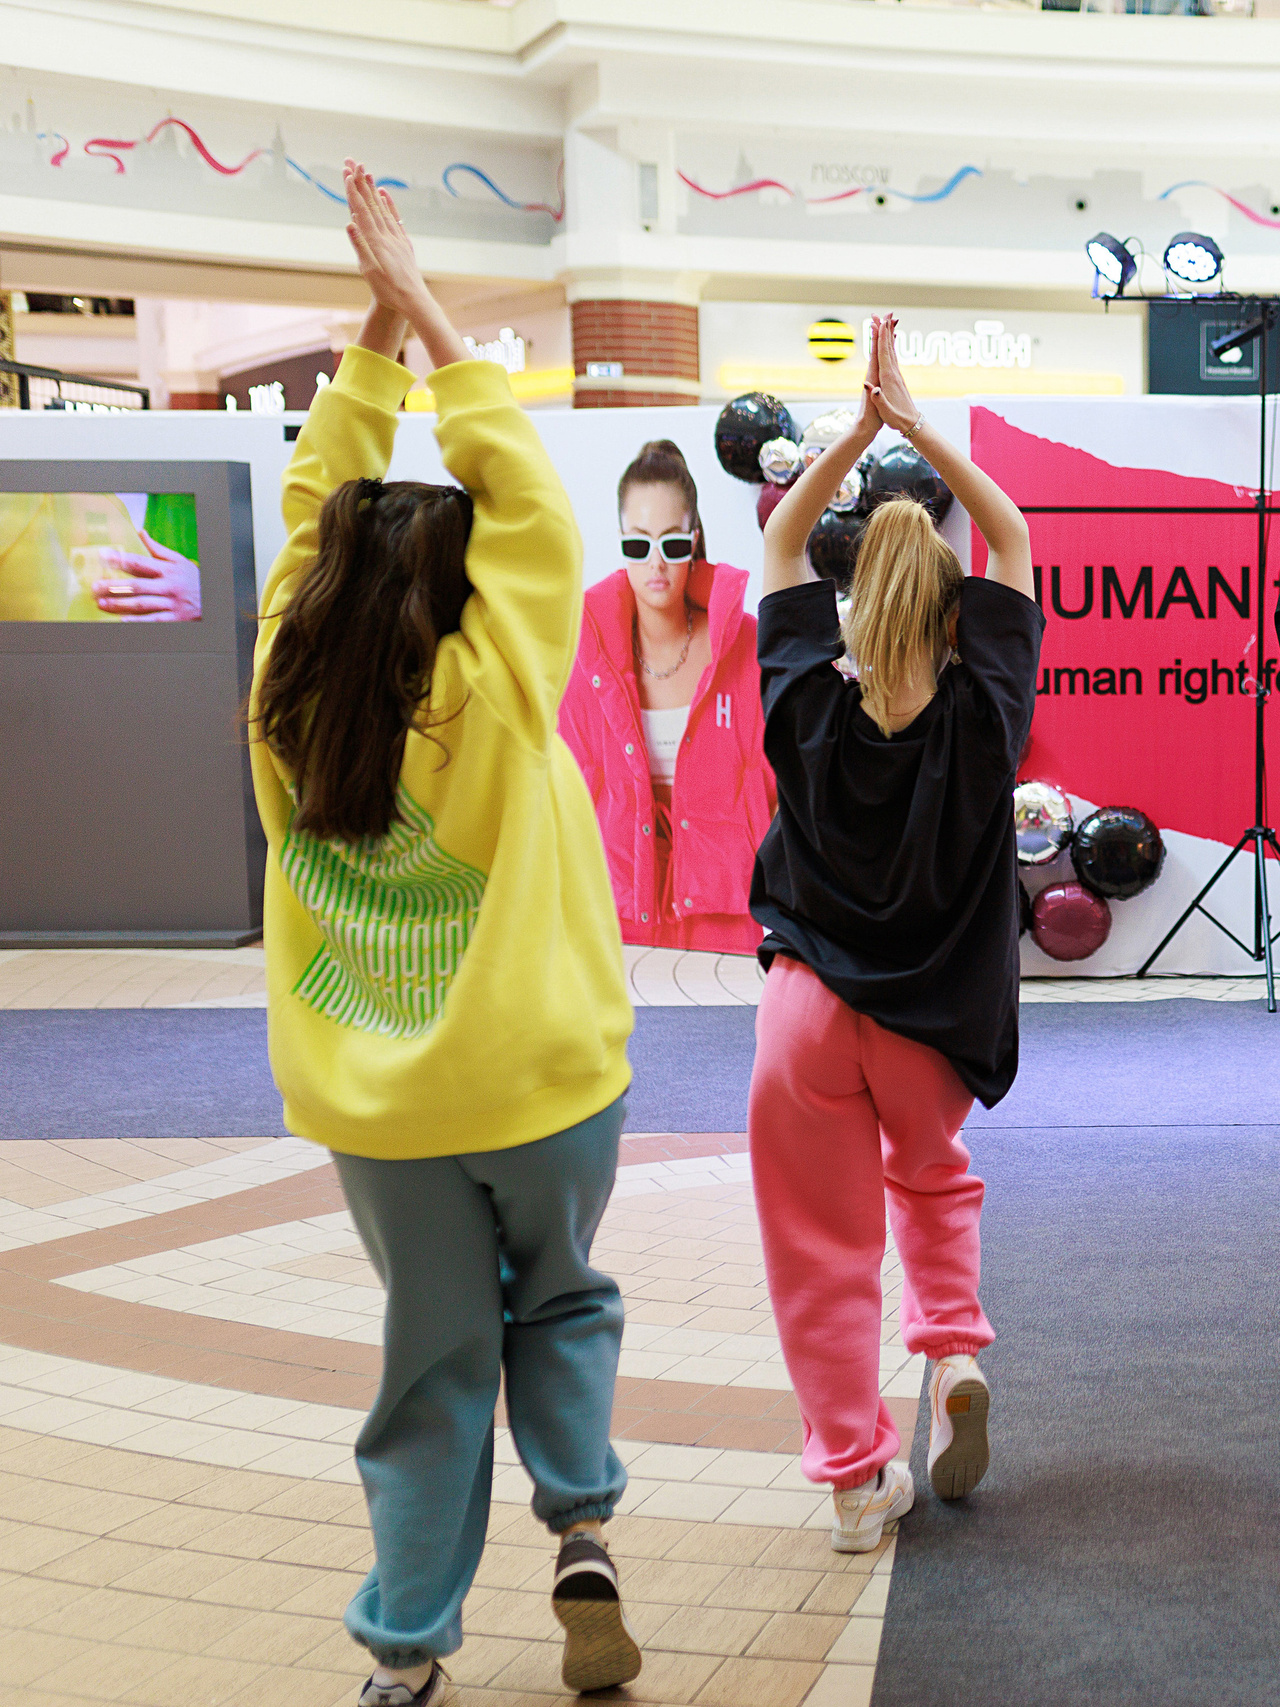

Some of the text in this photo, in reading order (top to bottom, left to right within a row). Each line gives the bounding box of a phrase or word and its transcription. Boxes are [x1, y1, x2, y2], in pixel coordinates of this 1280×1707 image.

[862, 319, 1032, 368] илайн
[1036, 665, 1142, 696] uman
[1159, 658, 1250, 704] right
[716, 692, 731, 729] H
